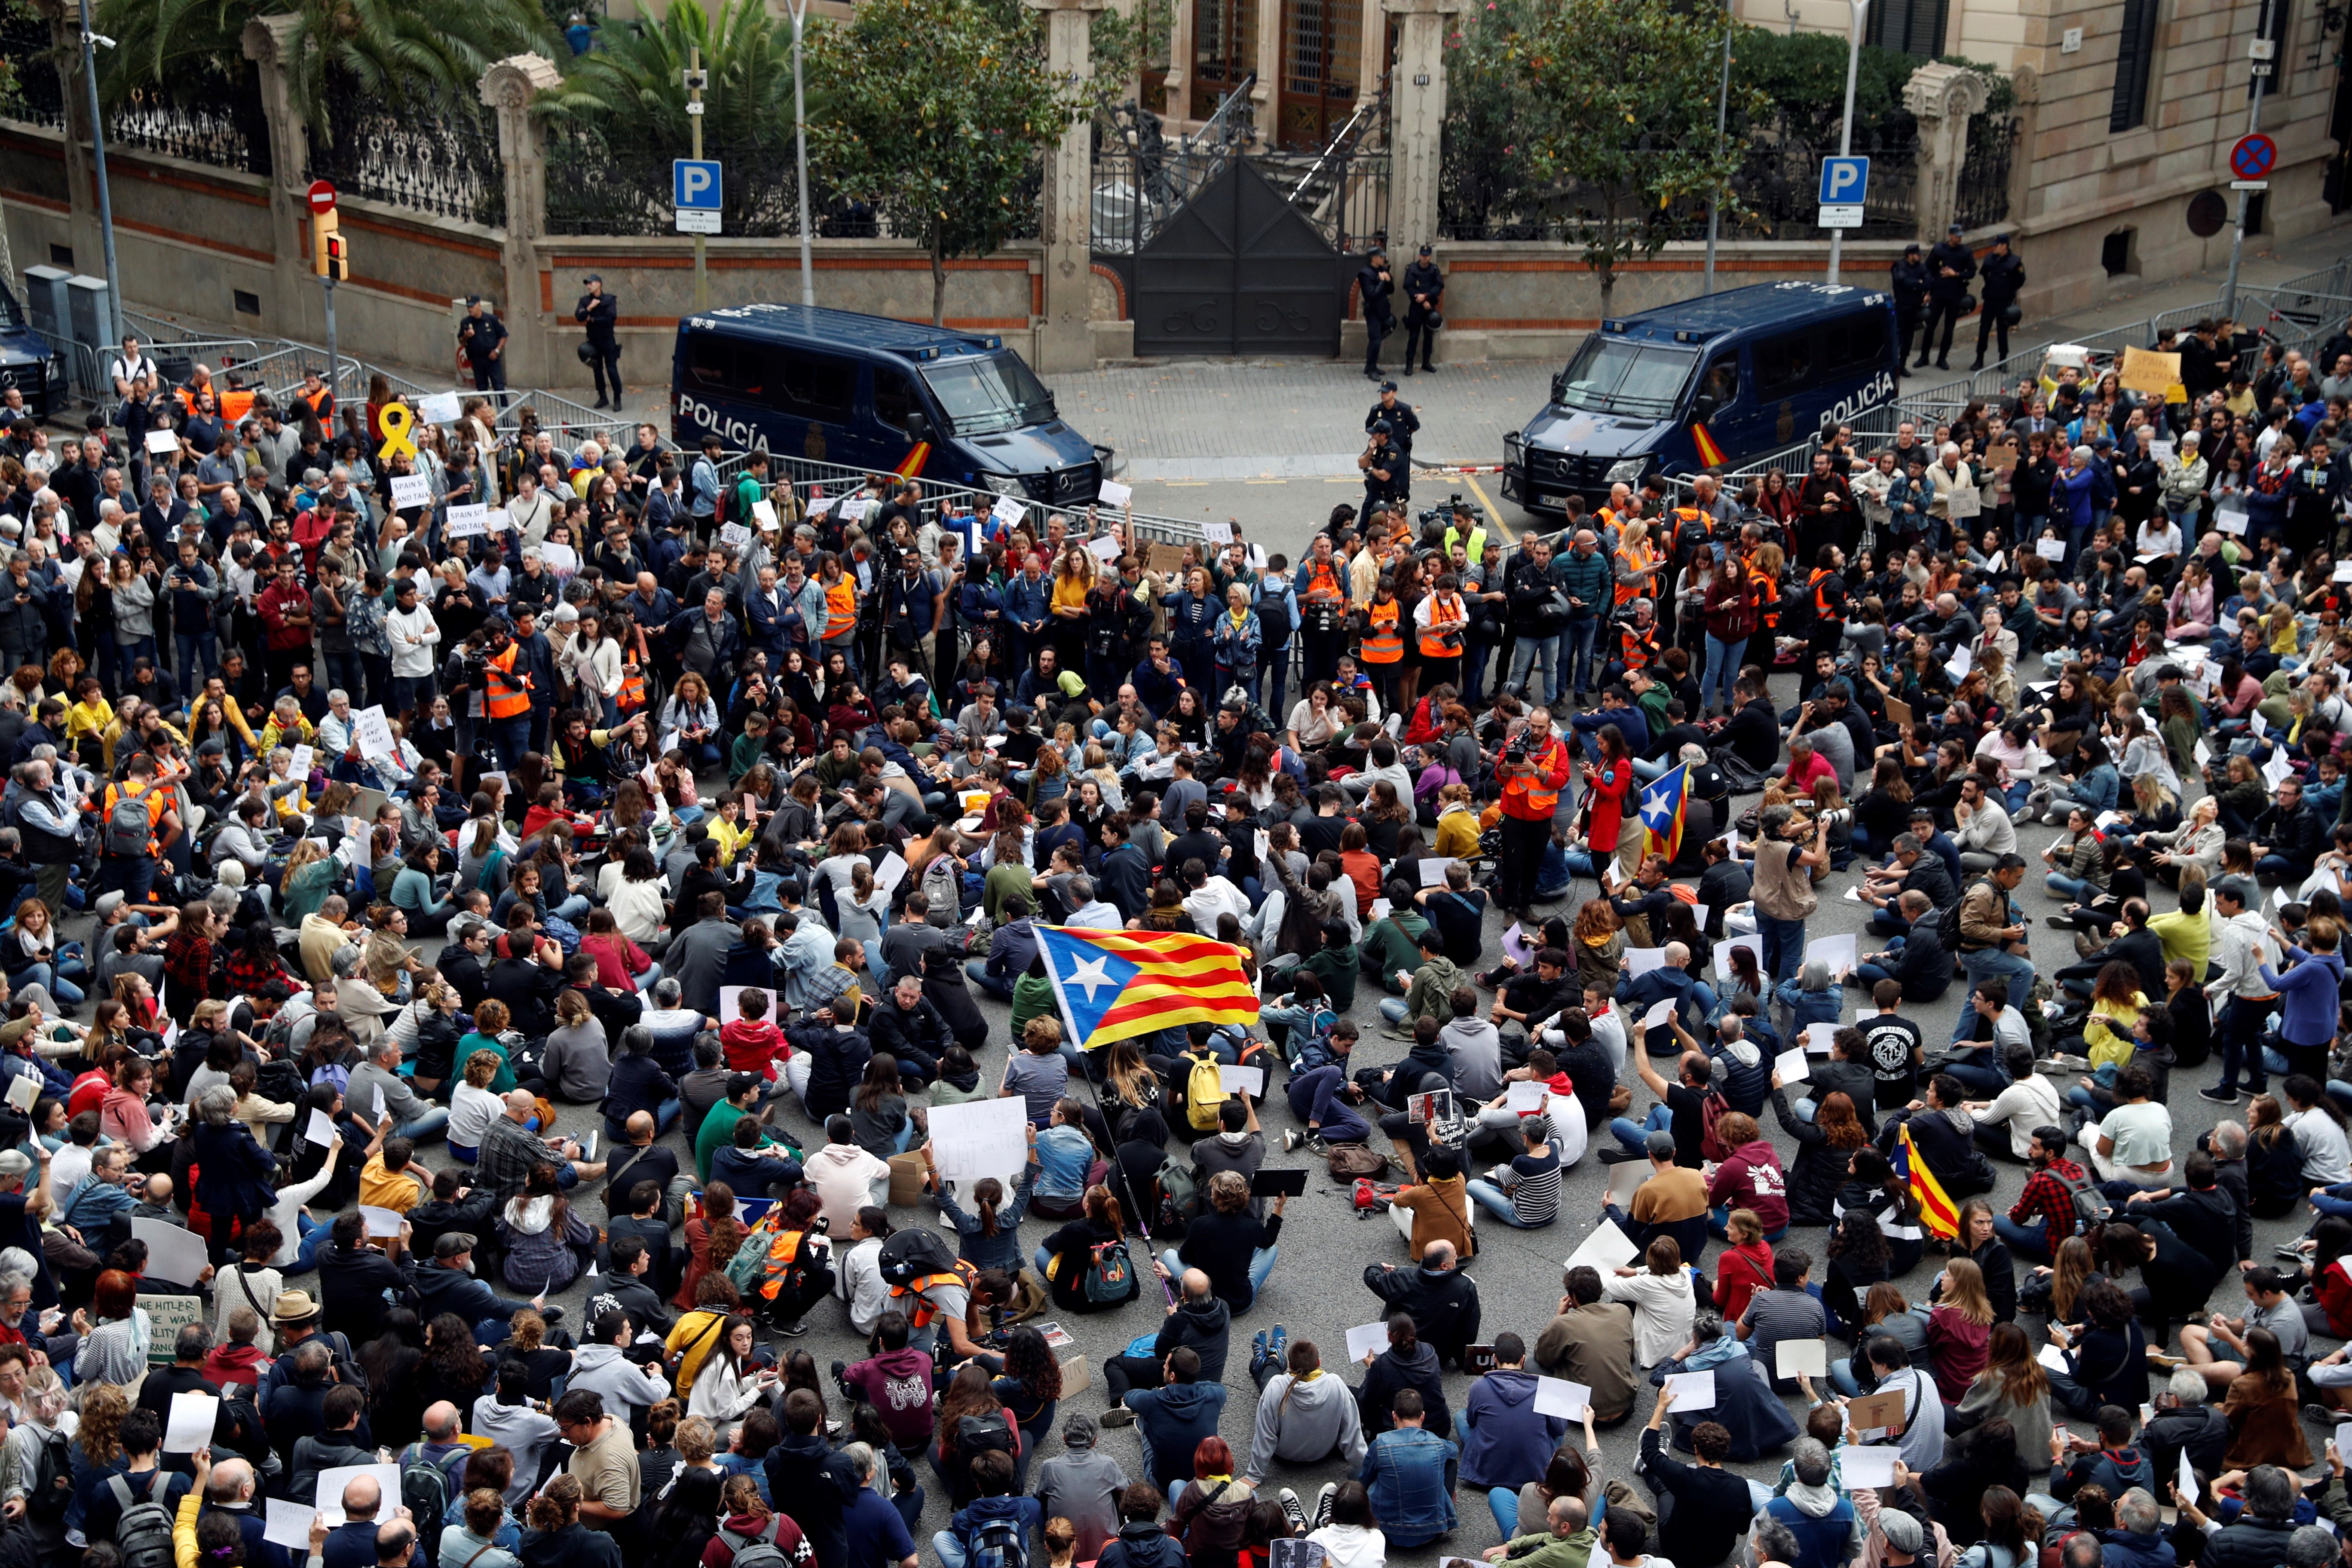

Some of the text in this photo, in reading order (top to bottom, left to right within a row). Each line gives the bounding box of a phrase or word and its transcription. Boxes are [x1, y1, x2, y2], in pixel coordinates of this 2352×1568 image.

[684, 166, 711, 202] P
[1829, 163, 1858, 199] P
[2133, 353, 2168, 368] SPAIN
[1820, 371, 1894, 426] POLICÍA
[679, 394, 769, 454] POLICÍA
[395, 481, 416, 491] SPAIN
[397, 491, 430, 503] AND TALK
[450, 508, 484, 520] SPAIN SIT
[452, 521, 486, 531] AND TALK
[368, 737, 383, 746] TALK
[1437, 1125, 1448, 1133] The
[155, 1301, 196, 1311] HITLER
[169, 1314, 195, 1324] WAR
